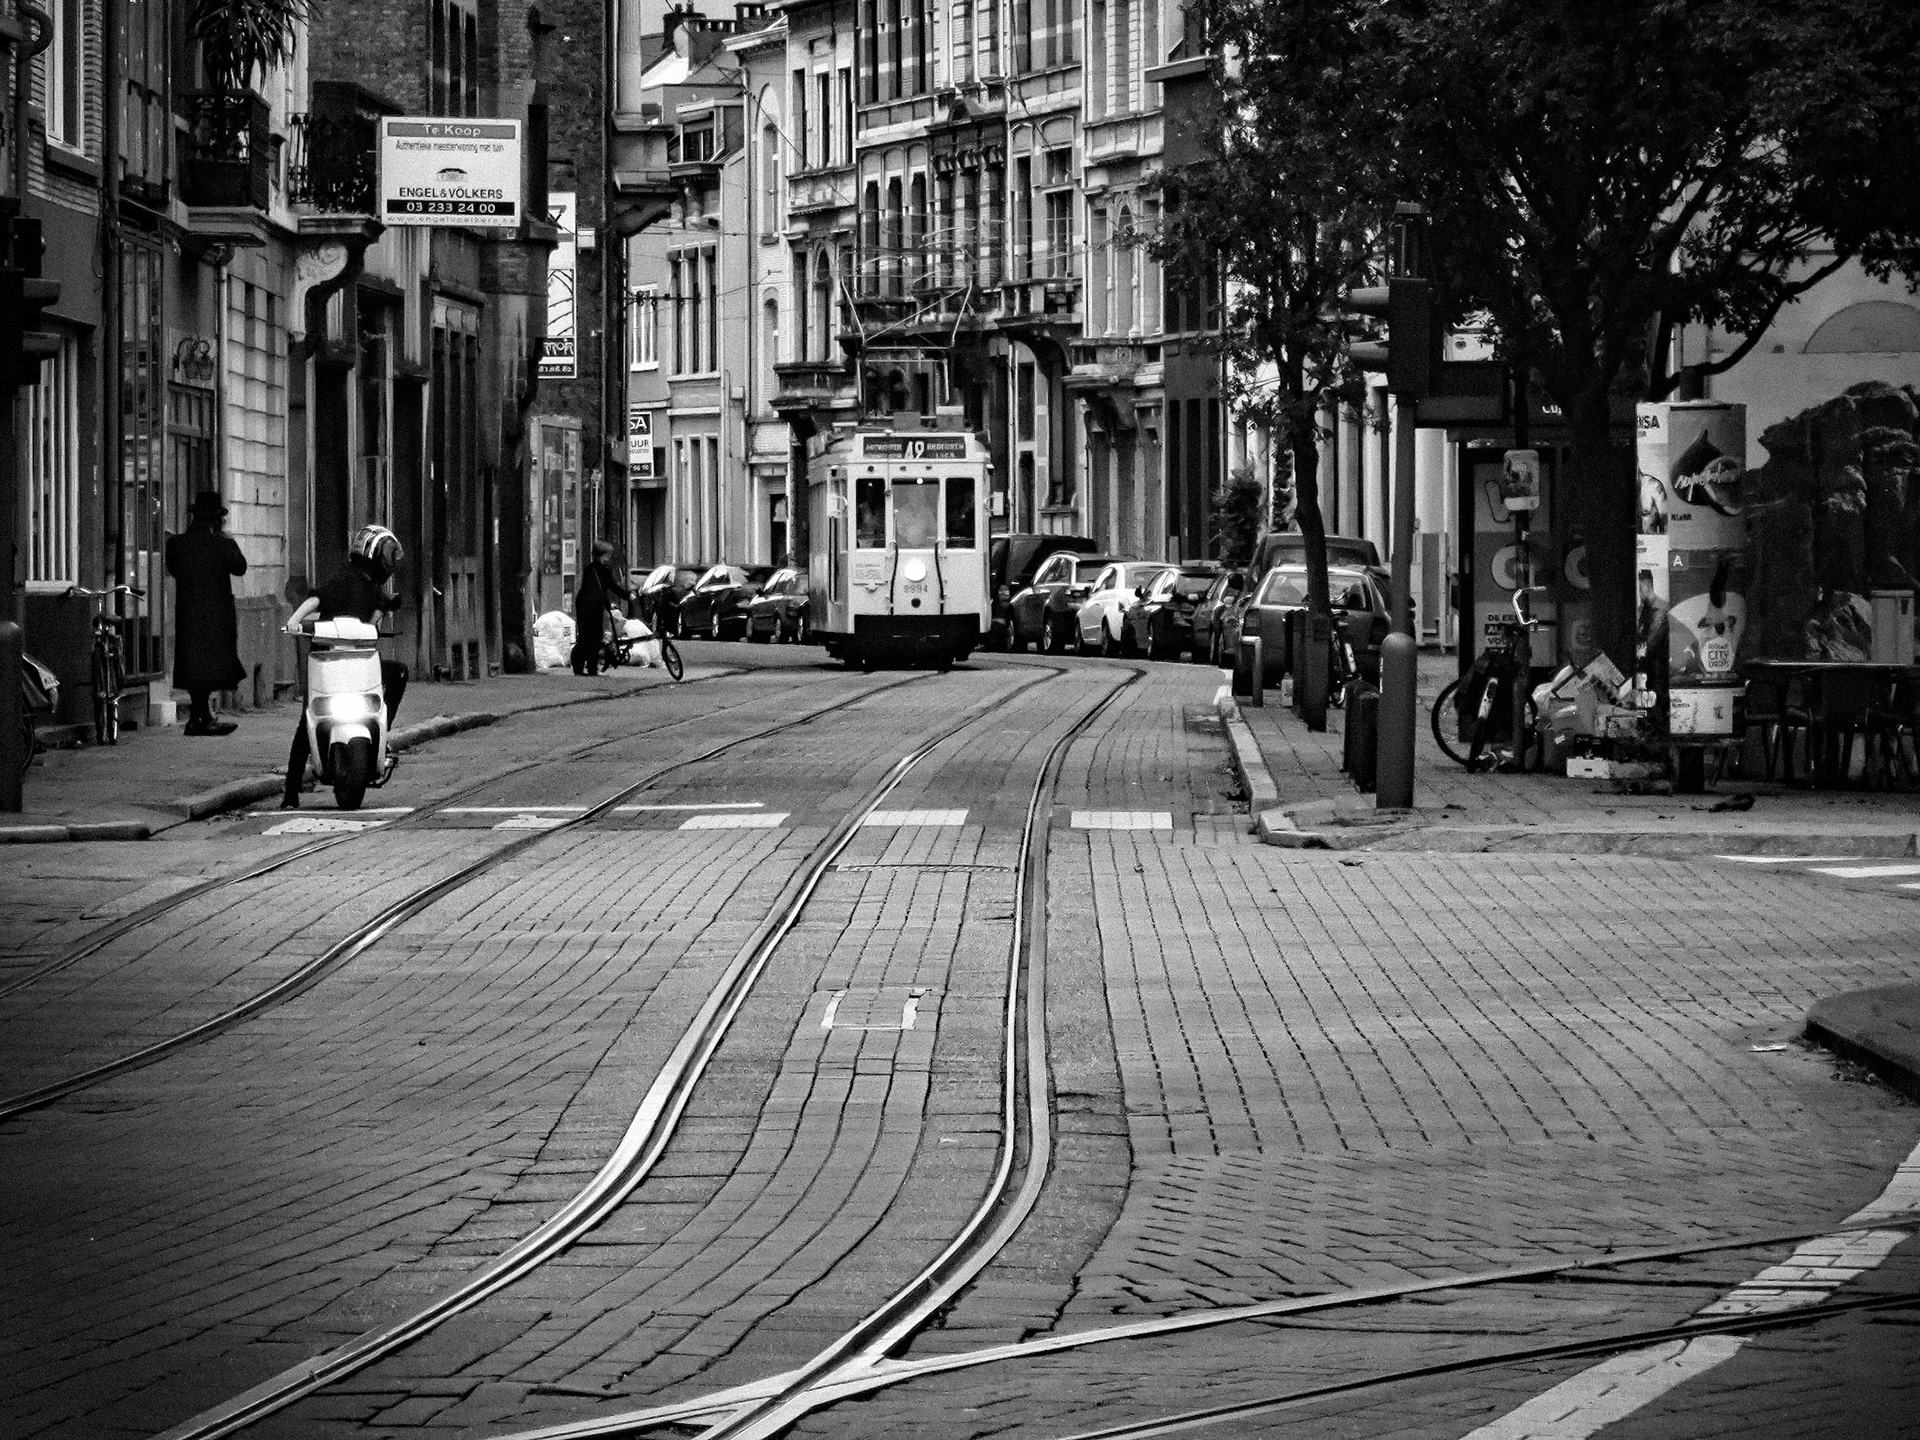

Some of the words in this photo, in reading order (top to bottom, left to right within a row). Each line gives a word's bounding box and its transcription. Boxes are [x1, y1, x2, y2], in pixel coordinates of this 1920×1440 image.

[424, 124, 439, 135] Te
[444, 125, 481, 137] Koop
[407, 202, 423, 212] 03
[428, 203, 453, 213] 233
[458, 203, 474, 213] 24
[479, 204, 496, 213] 00
[1672, 555, 1684, 567] A
